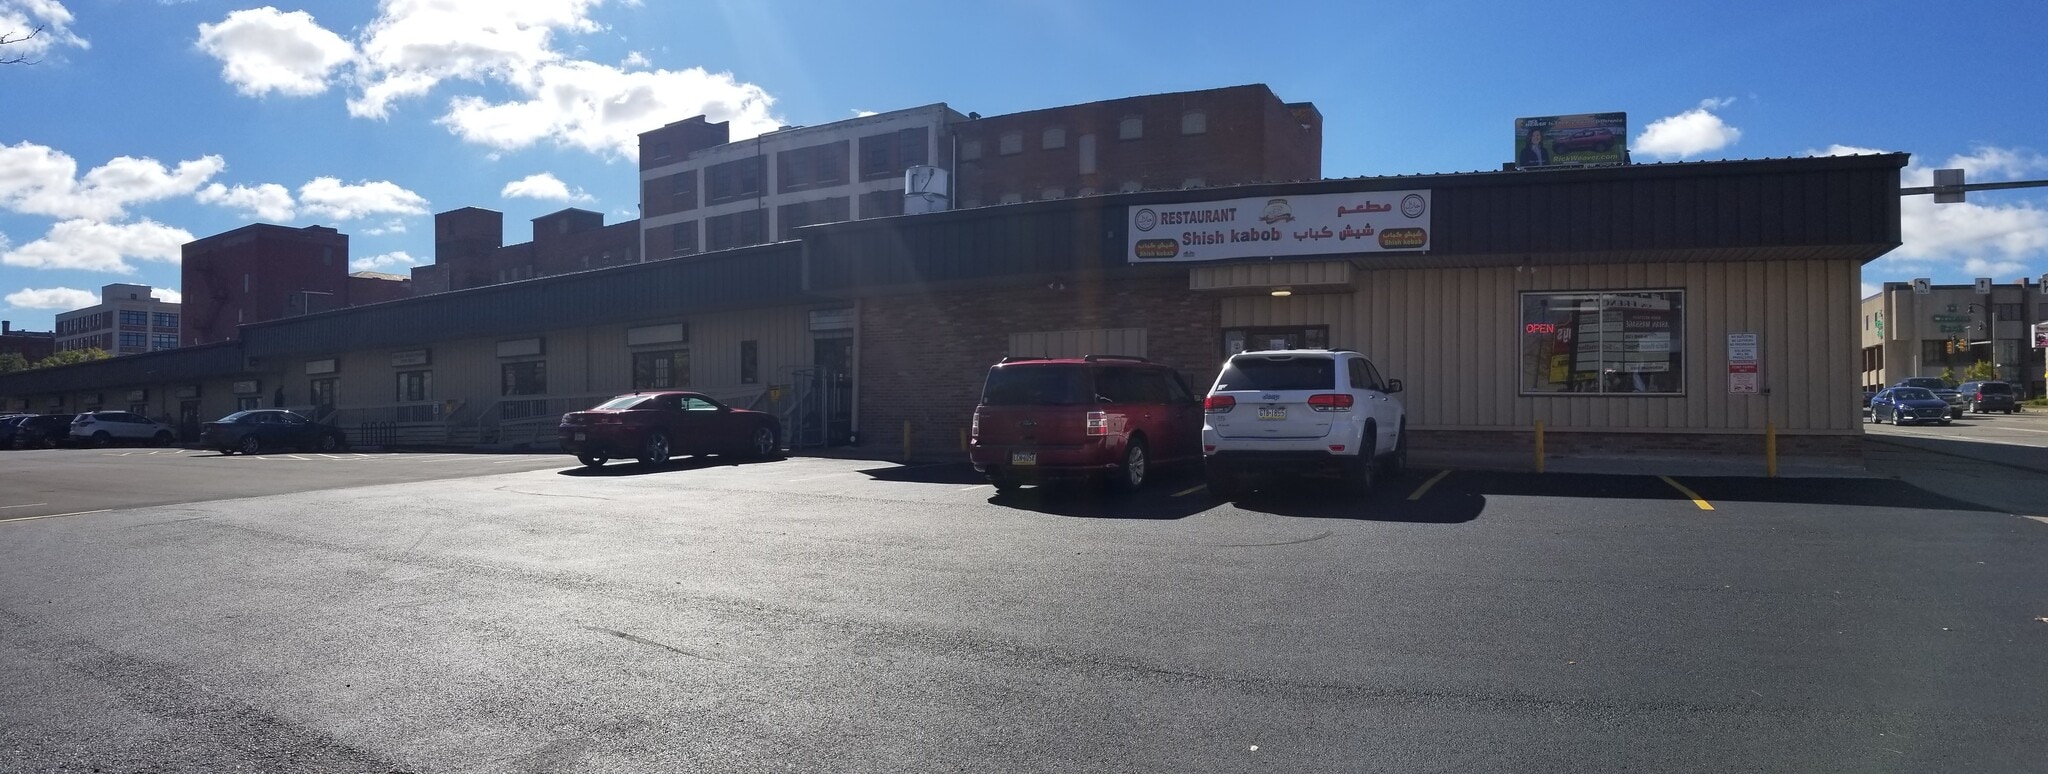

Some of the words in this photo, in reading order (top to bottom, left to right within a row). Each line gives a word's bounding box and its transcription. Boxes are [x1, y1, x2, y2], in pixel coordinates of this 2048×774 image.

[1552, 154, 1618, 162] RickWeaver.com
[1161, 208, 1237, 225] RESTAURANT
[1338, 201, 1392, 217] مطعم
[1182, 231, 1225, 246] Shish
[1230, 227, 1281, 243] kabob
[1293, 225, 1334, 242] كباب
[1339, 222, 1375, 241] شيش
[1526, 323, 1555, 334] OPEN
